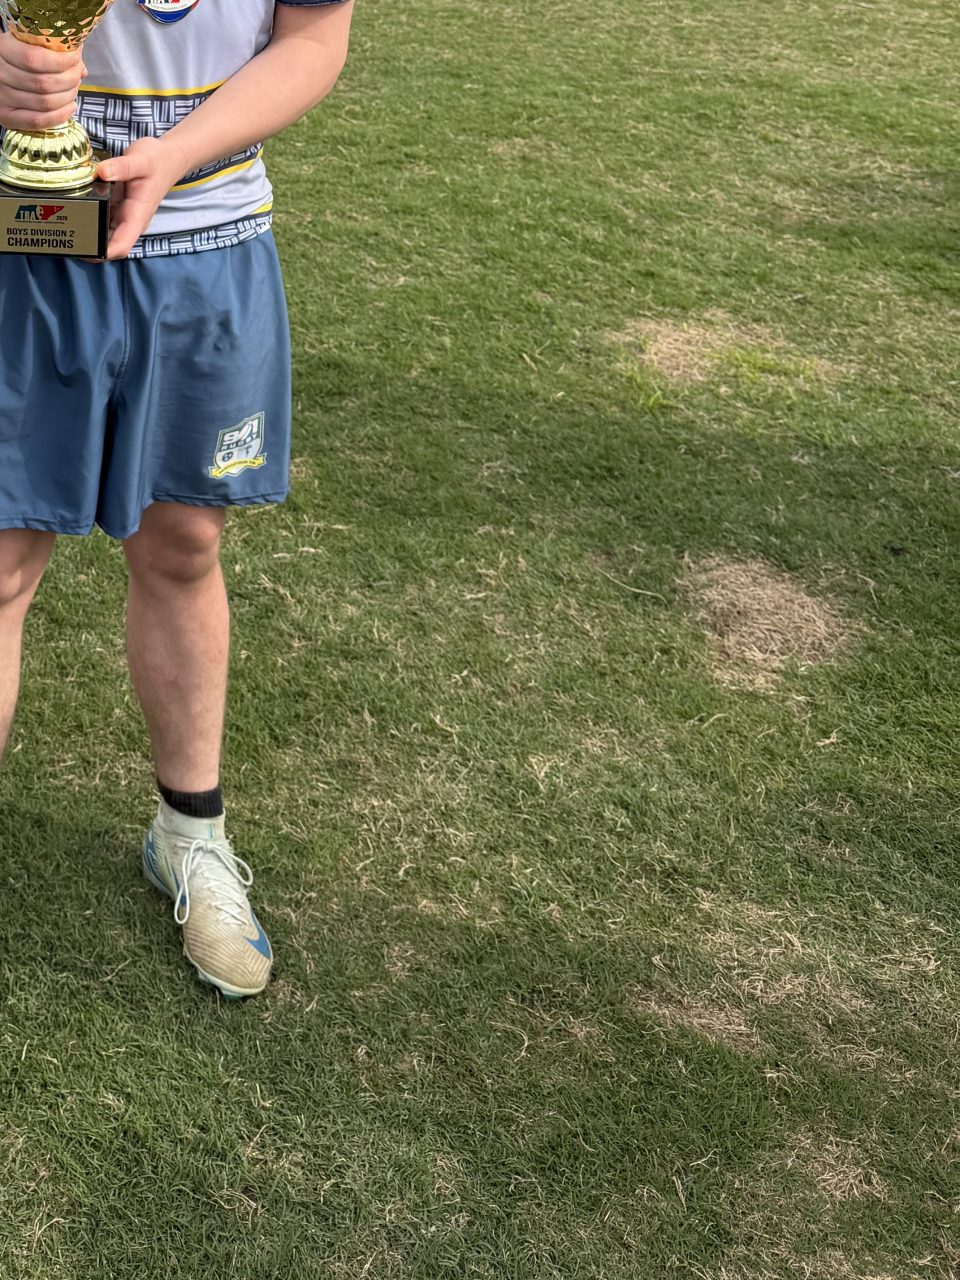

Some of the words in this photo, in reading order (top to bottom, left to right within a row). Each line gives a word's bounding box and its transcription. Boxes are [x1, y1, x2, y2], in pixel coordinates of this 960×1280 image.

[19, 210, 36, 220] TRA
[6, 227, 28, 236] BOYS
[30, 228, 67, 237] DIVISION
[7, 237, 74, 248] CHAMPIONS
